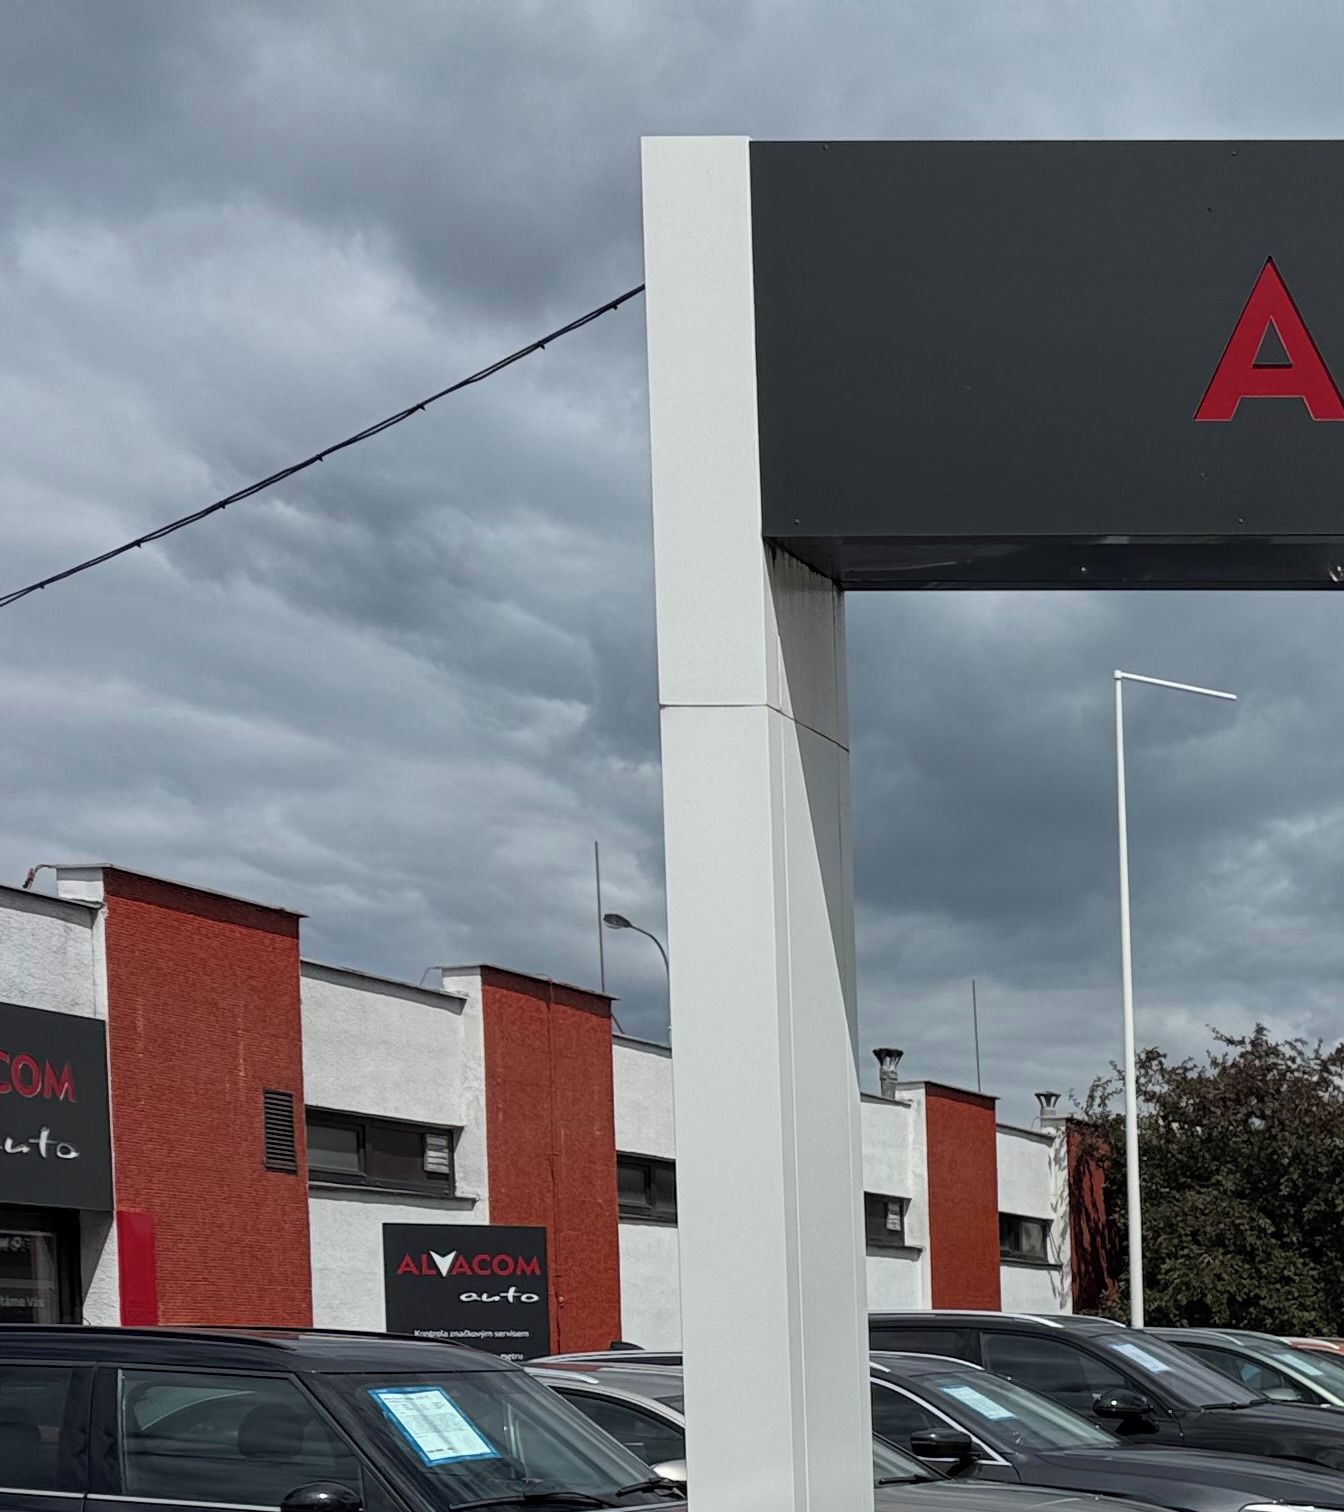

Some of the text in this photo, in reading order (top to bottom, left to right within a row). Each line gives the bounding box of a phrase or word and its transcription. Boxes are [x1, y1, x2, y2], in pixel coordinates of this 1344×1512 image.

[396, 1250, 542, 1277] ALVACOM
[459, 1286, 540, 1303] auto
[414, 1330, 448, 1338] Kontrola
[494, 1330, 529, 1338] servisem
